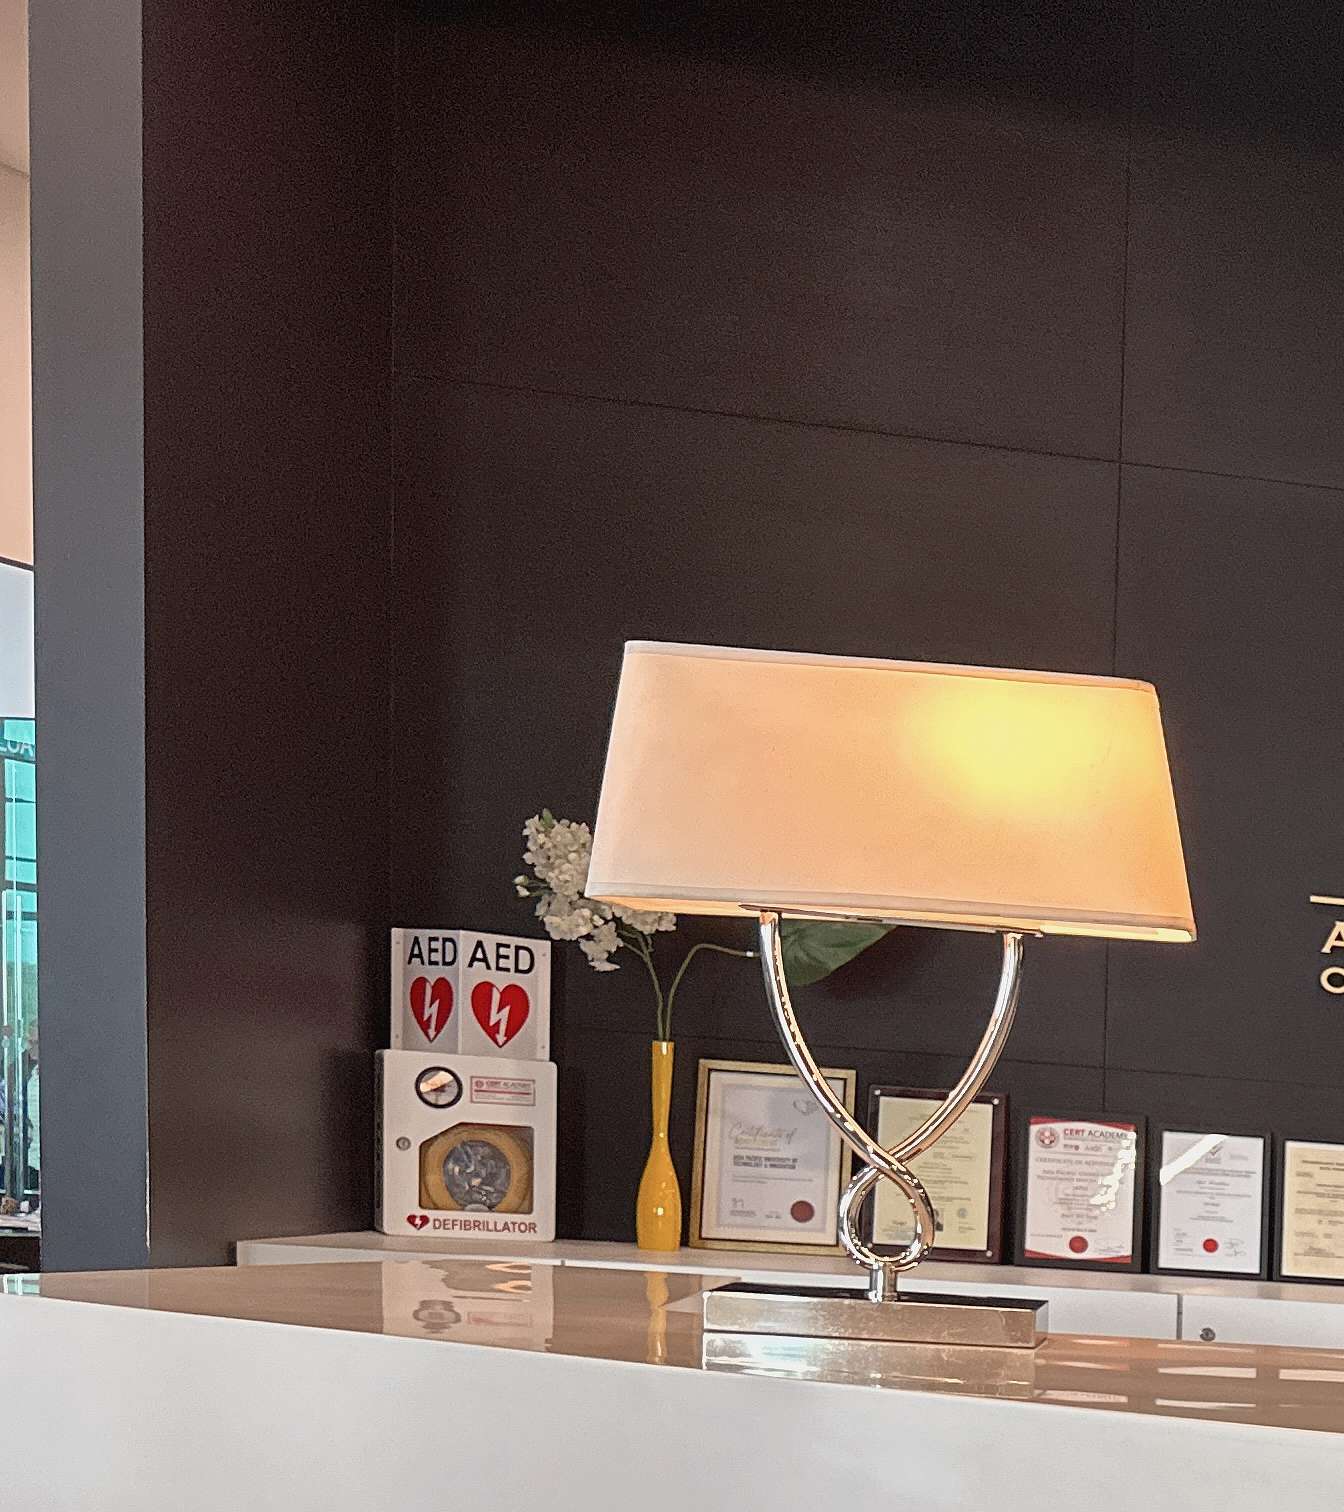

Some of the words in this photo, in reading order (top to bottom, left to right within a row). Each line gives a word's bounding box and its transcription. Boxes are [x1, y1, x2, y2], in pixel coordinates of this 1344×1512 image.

[407, 935, 457, 967] AED
[467, 939, 535, 975] AED
[1063, 1128, 1085, 1137] CERT
[432, 1218, 538, 1234] DEFIBRILLATOR
